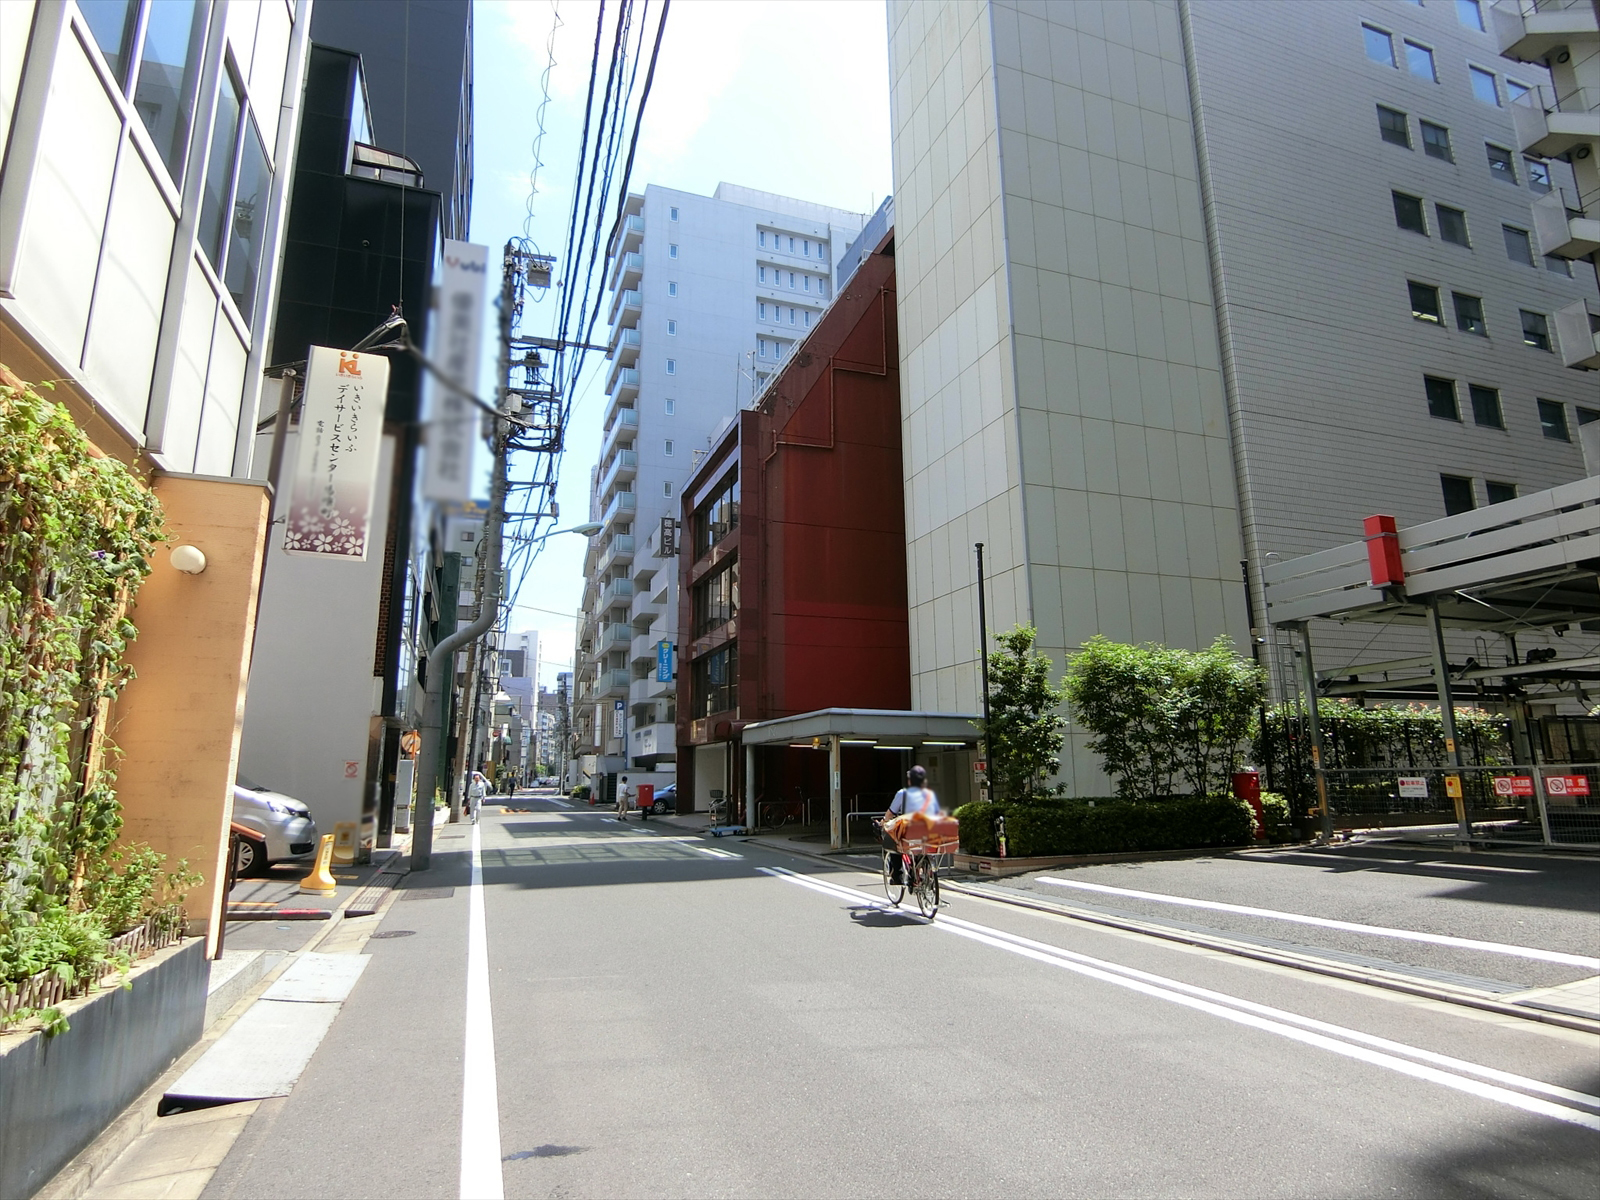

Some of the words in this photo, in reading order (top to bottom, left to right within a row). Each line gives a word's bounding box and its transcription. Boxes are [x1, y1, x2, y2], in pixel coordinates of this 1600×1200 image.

[345, 385, 364, 453] いきいきらいふ
[663, 518, 673, 555] 穂高ビル
[662, 648, 670, 680] クリーニング
